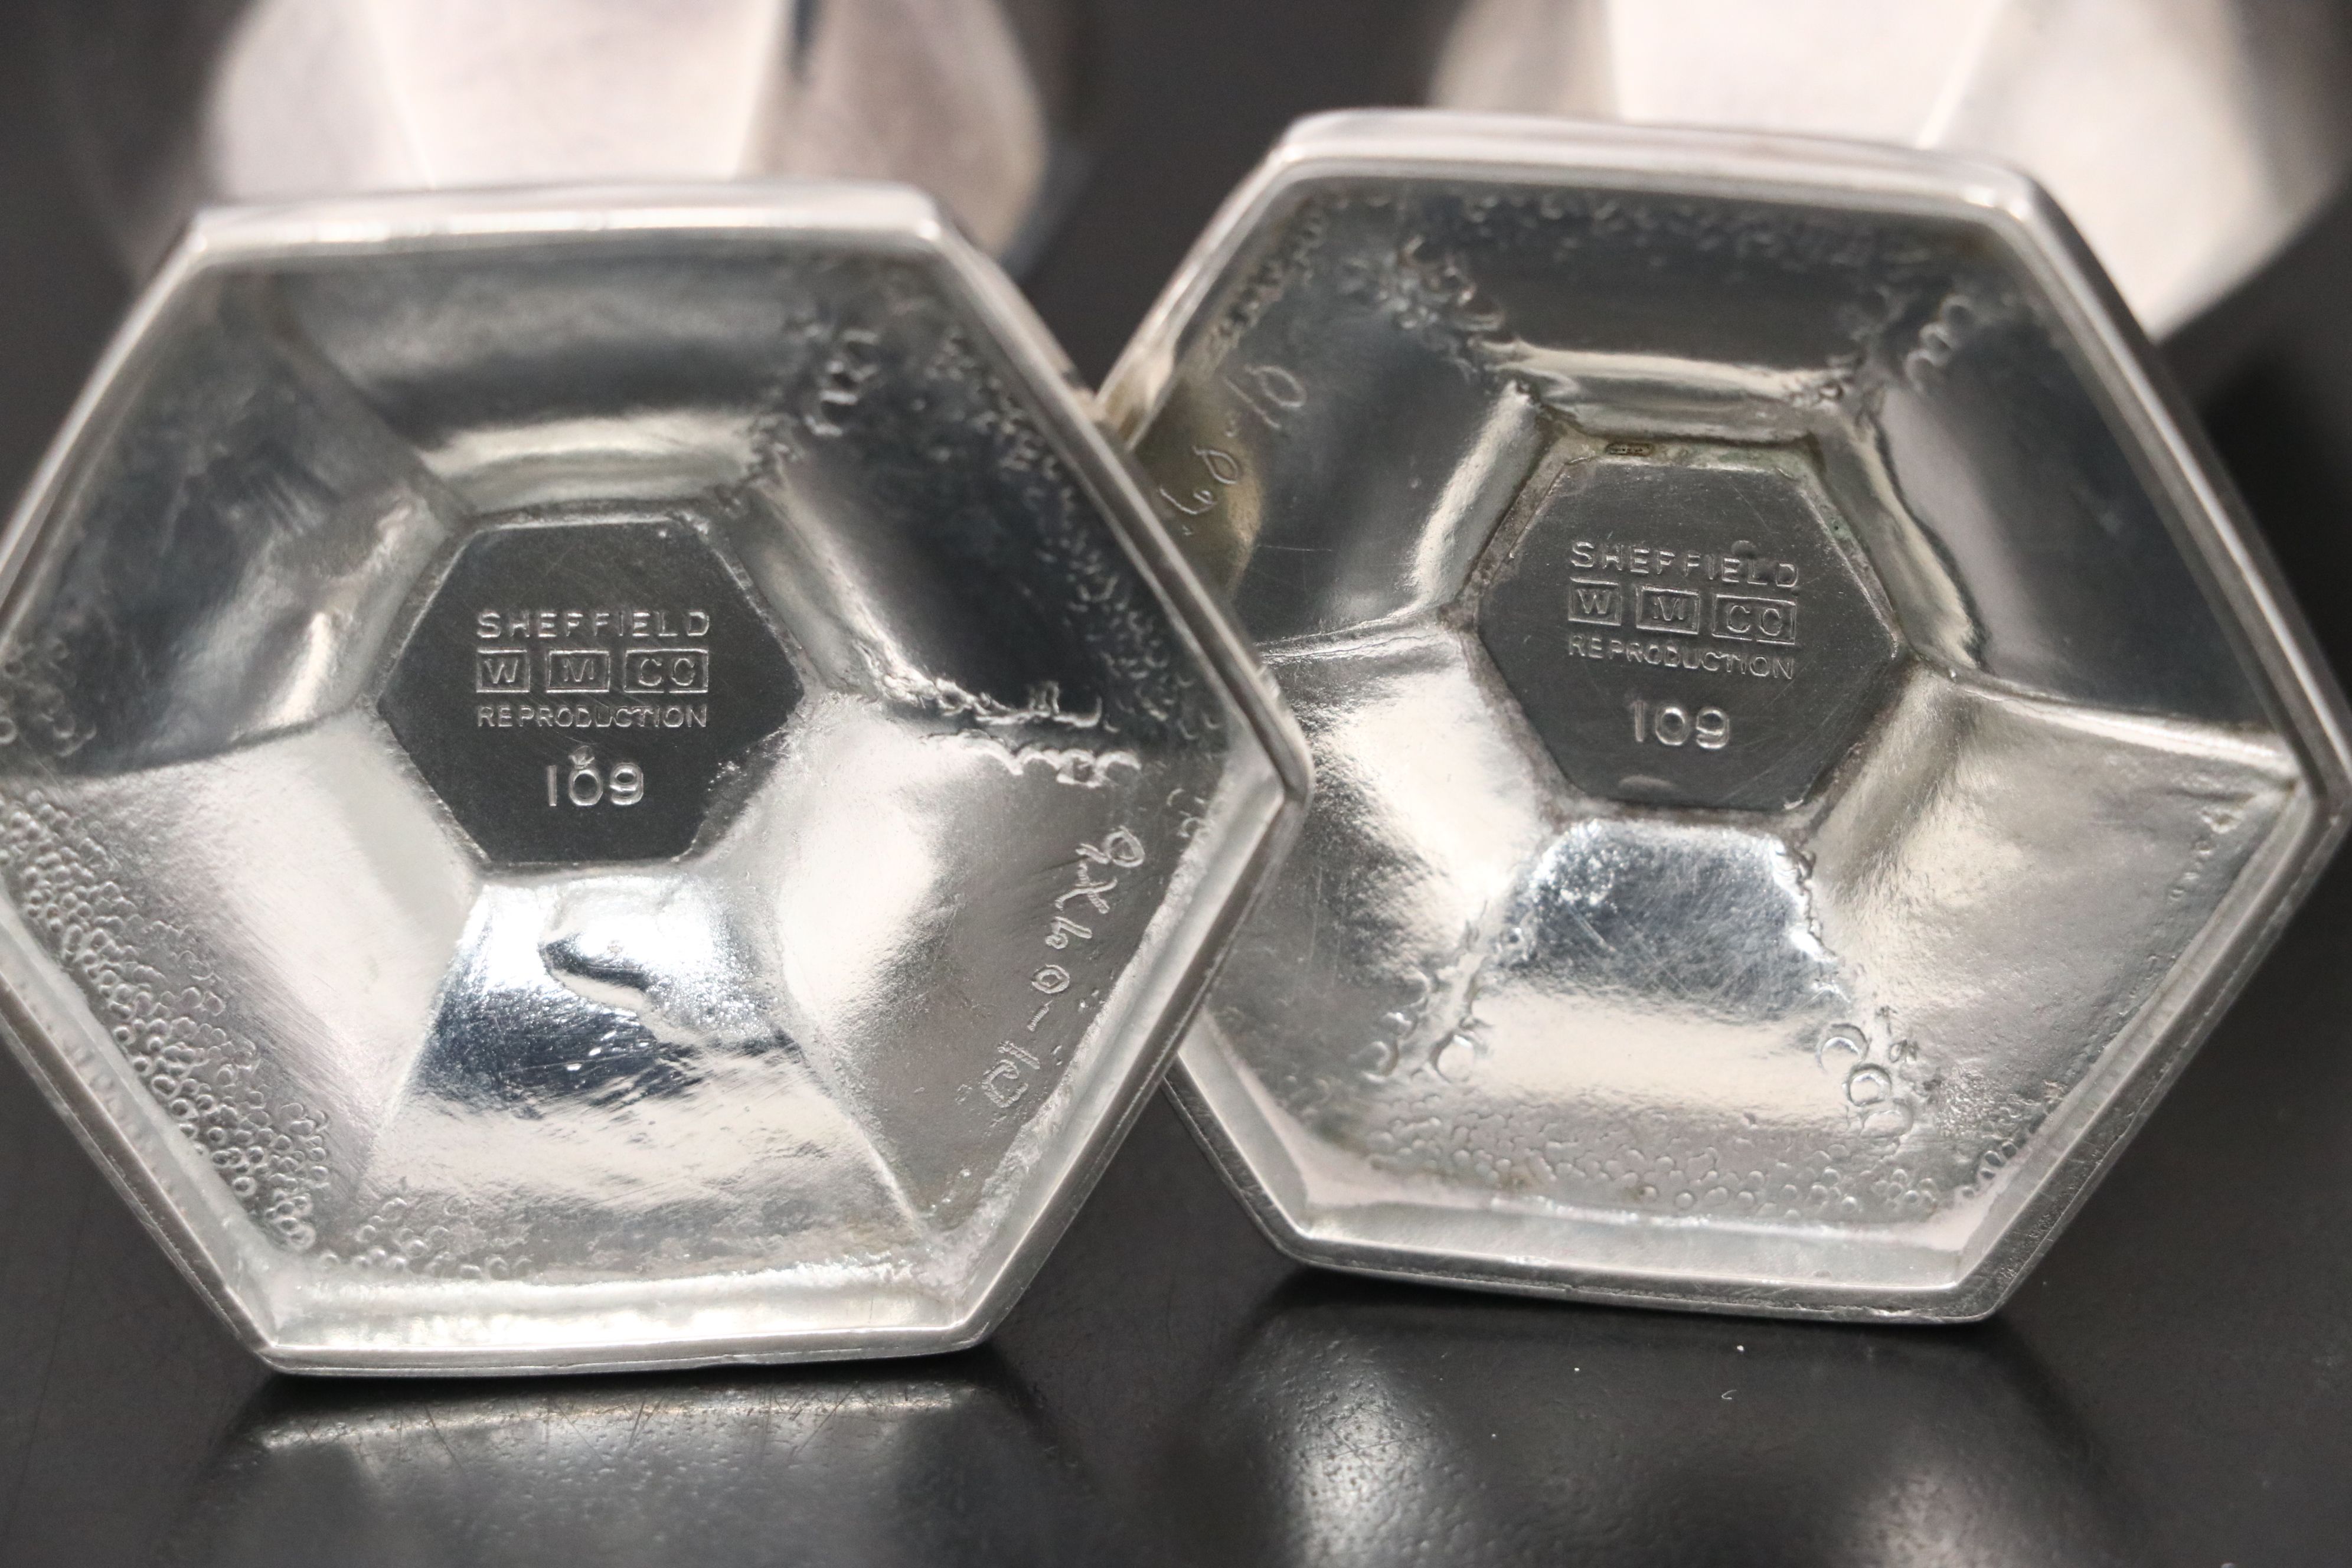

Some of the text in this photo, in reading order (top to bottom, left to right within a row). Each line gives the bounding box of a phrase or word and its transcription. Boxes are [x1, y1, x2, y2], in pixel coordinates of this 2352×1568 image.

[1570, 541, 1798, 587] SHEFFIELD
[477, 609, 710, 638] SHEFFIELD
[638, 658, 695, 687] CC
[1569, 634, 1795, 680] REPRODUCTION
[477, 706, 707, 728] REPRODUCTION
[1631, 700, 1730, 750] 109
[546, 762, 644, 807] 109
